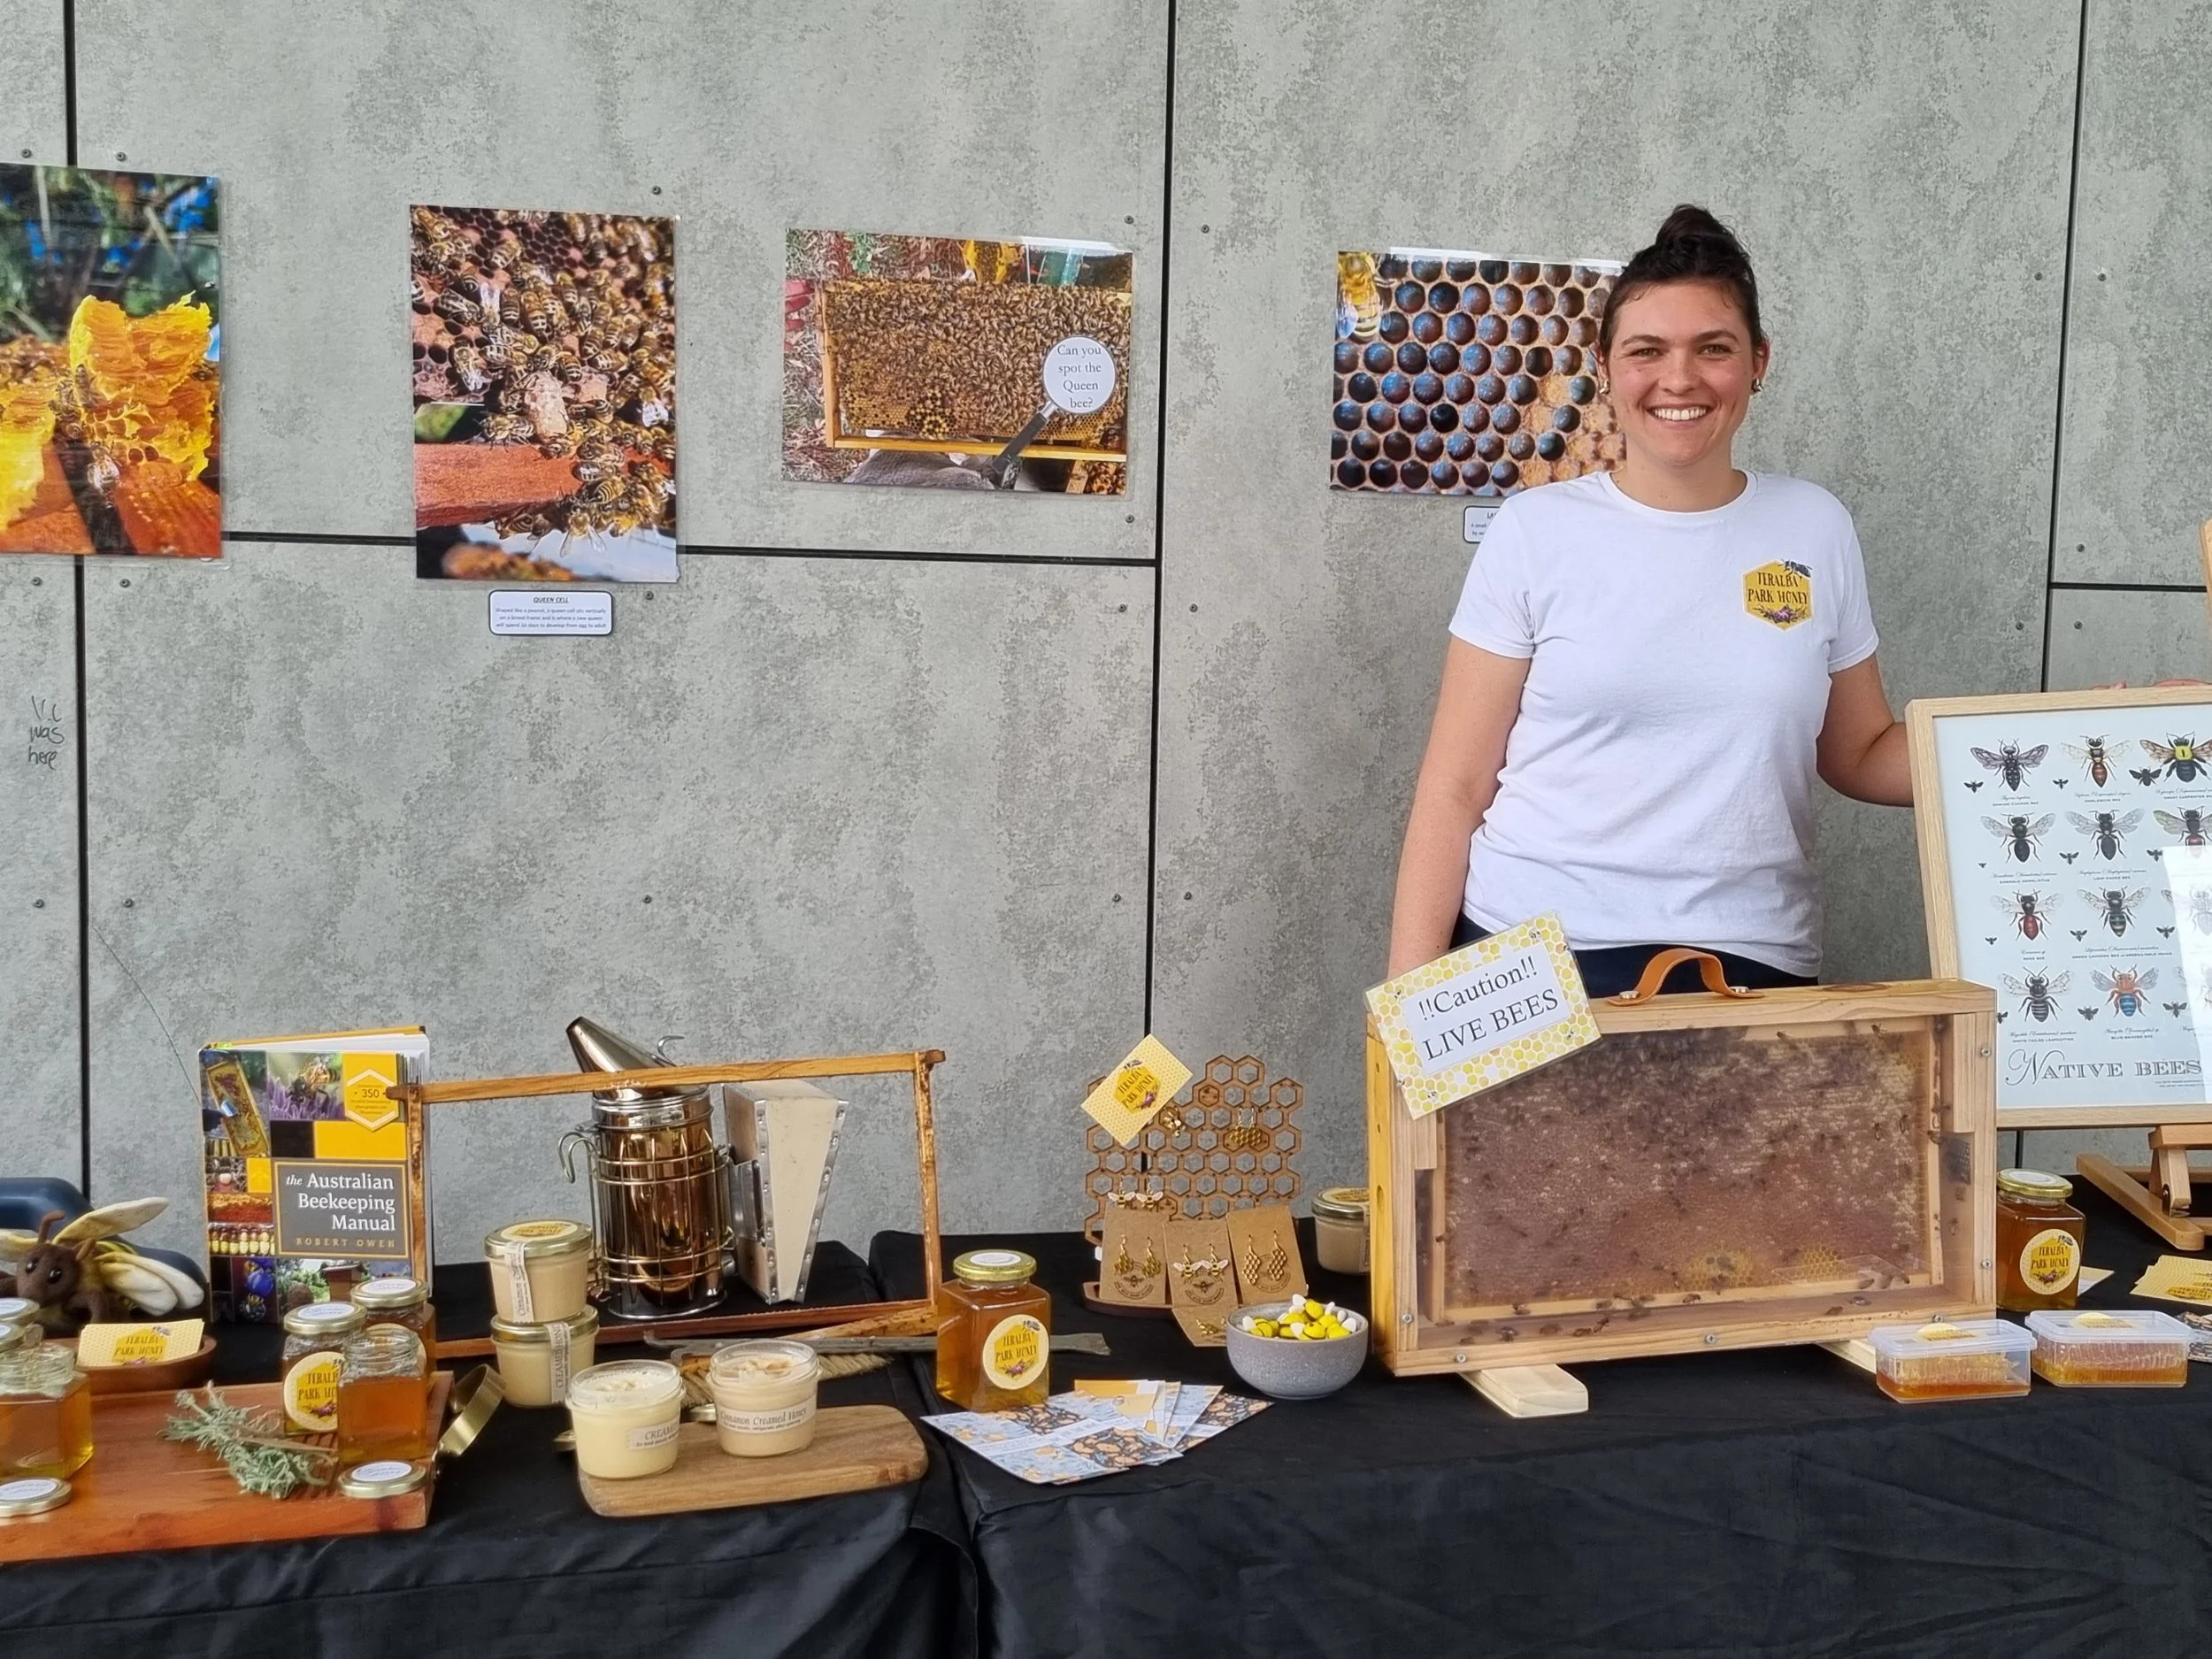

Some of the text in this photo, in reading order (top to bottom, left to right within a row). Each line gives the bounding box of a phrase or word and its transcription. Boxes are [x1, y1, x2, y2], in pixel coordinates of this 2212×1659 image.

[1057, 344, 1102, 358] Can you
[1058, 362, 1102, 376] spot the
[1063, 380, 1099, 393] Queen
[1070, 397, 1094, 408] bee?
[1757, 572, 1799, 588] TERALBA
[1747, 588, 1808, 604] PARK HONEY
[29, 726, 65, 744] was
[28, 745, 58, 771] here
[1418, 956, 1538, 1021] !!Caution!!
[1423, 988, 1558, 1061] LIVE BEES
[2005, 1048, 2202, 1086] NATIVE BEES
[361, 1088, 380, 1098] 350
[286, 1172, 394, 1189] the Australian
[298, 1193, 396, 1214] Beekeeping
[332, 1214, 396, 1231] Manual
[296, 1238, 395, 1248] ROBERT OWEN
[995, 1349, 1013, 1363] PARK
[297, 1387, 320, 1401] PARK
[753, 1410, 786, 1425] Creamed
